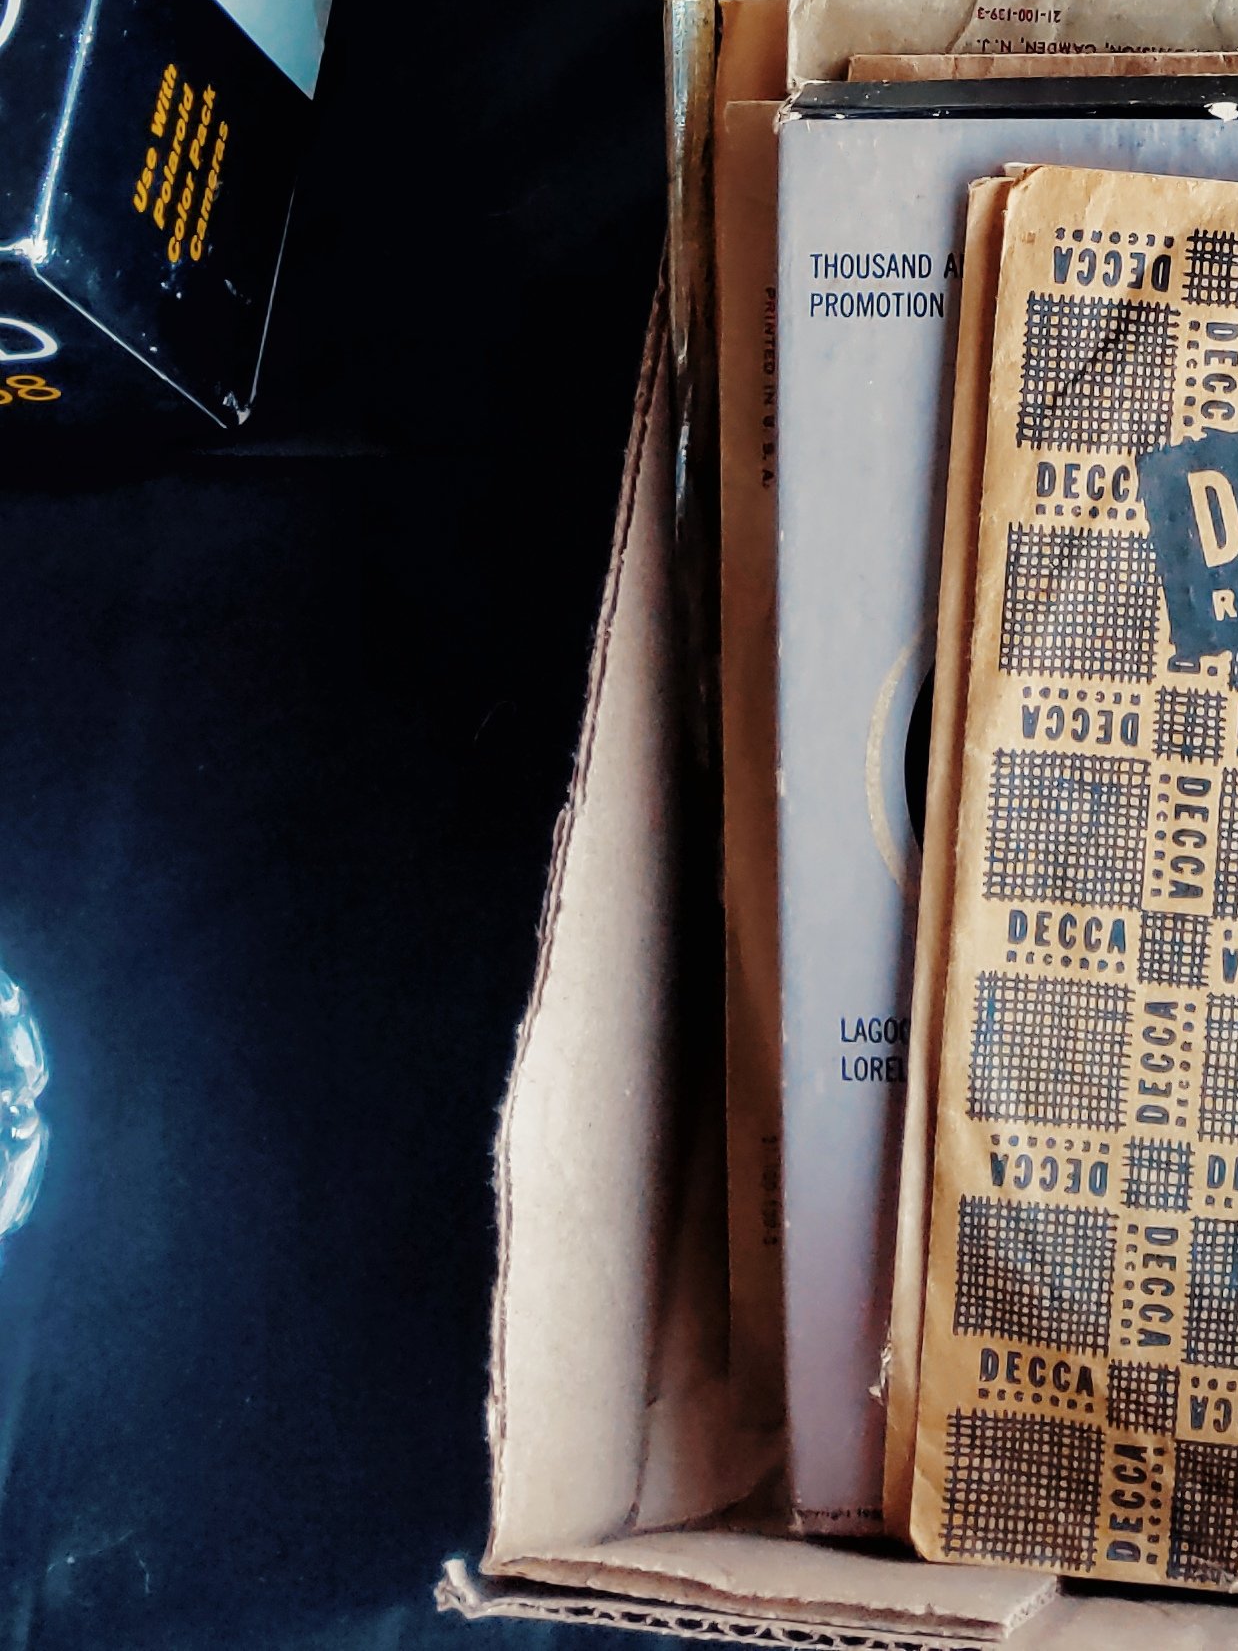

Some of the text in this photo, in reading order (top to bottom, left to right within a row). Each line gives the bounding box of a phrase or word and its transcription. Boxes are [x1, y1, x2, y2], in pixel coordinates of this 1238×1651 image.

[133, 63, 177, 213] Use With
[153, 82, 194, 231] Polaroid
[168, 84, 216, 263] Color Pack
[190, 121, 228, 261] Cameras
[810, 253, 932, 279] THOUSAND
[1052, 245, 1171, 293] DECCA
[810, 291, 944, 318] PROMOTION
[1009, 909, 1126, 953] DECCA
[981, 1349, 1095, 1396] DECCA
